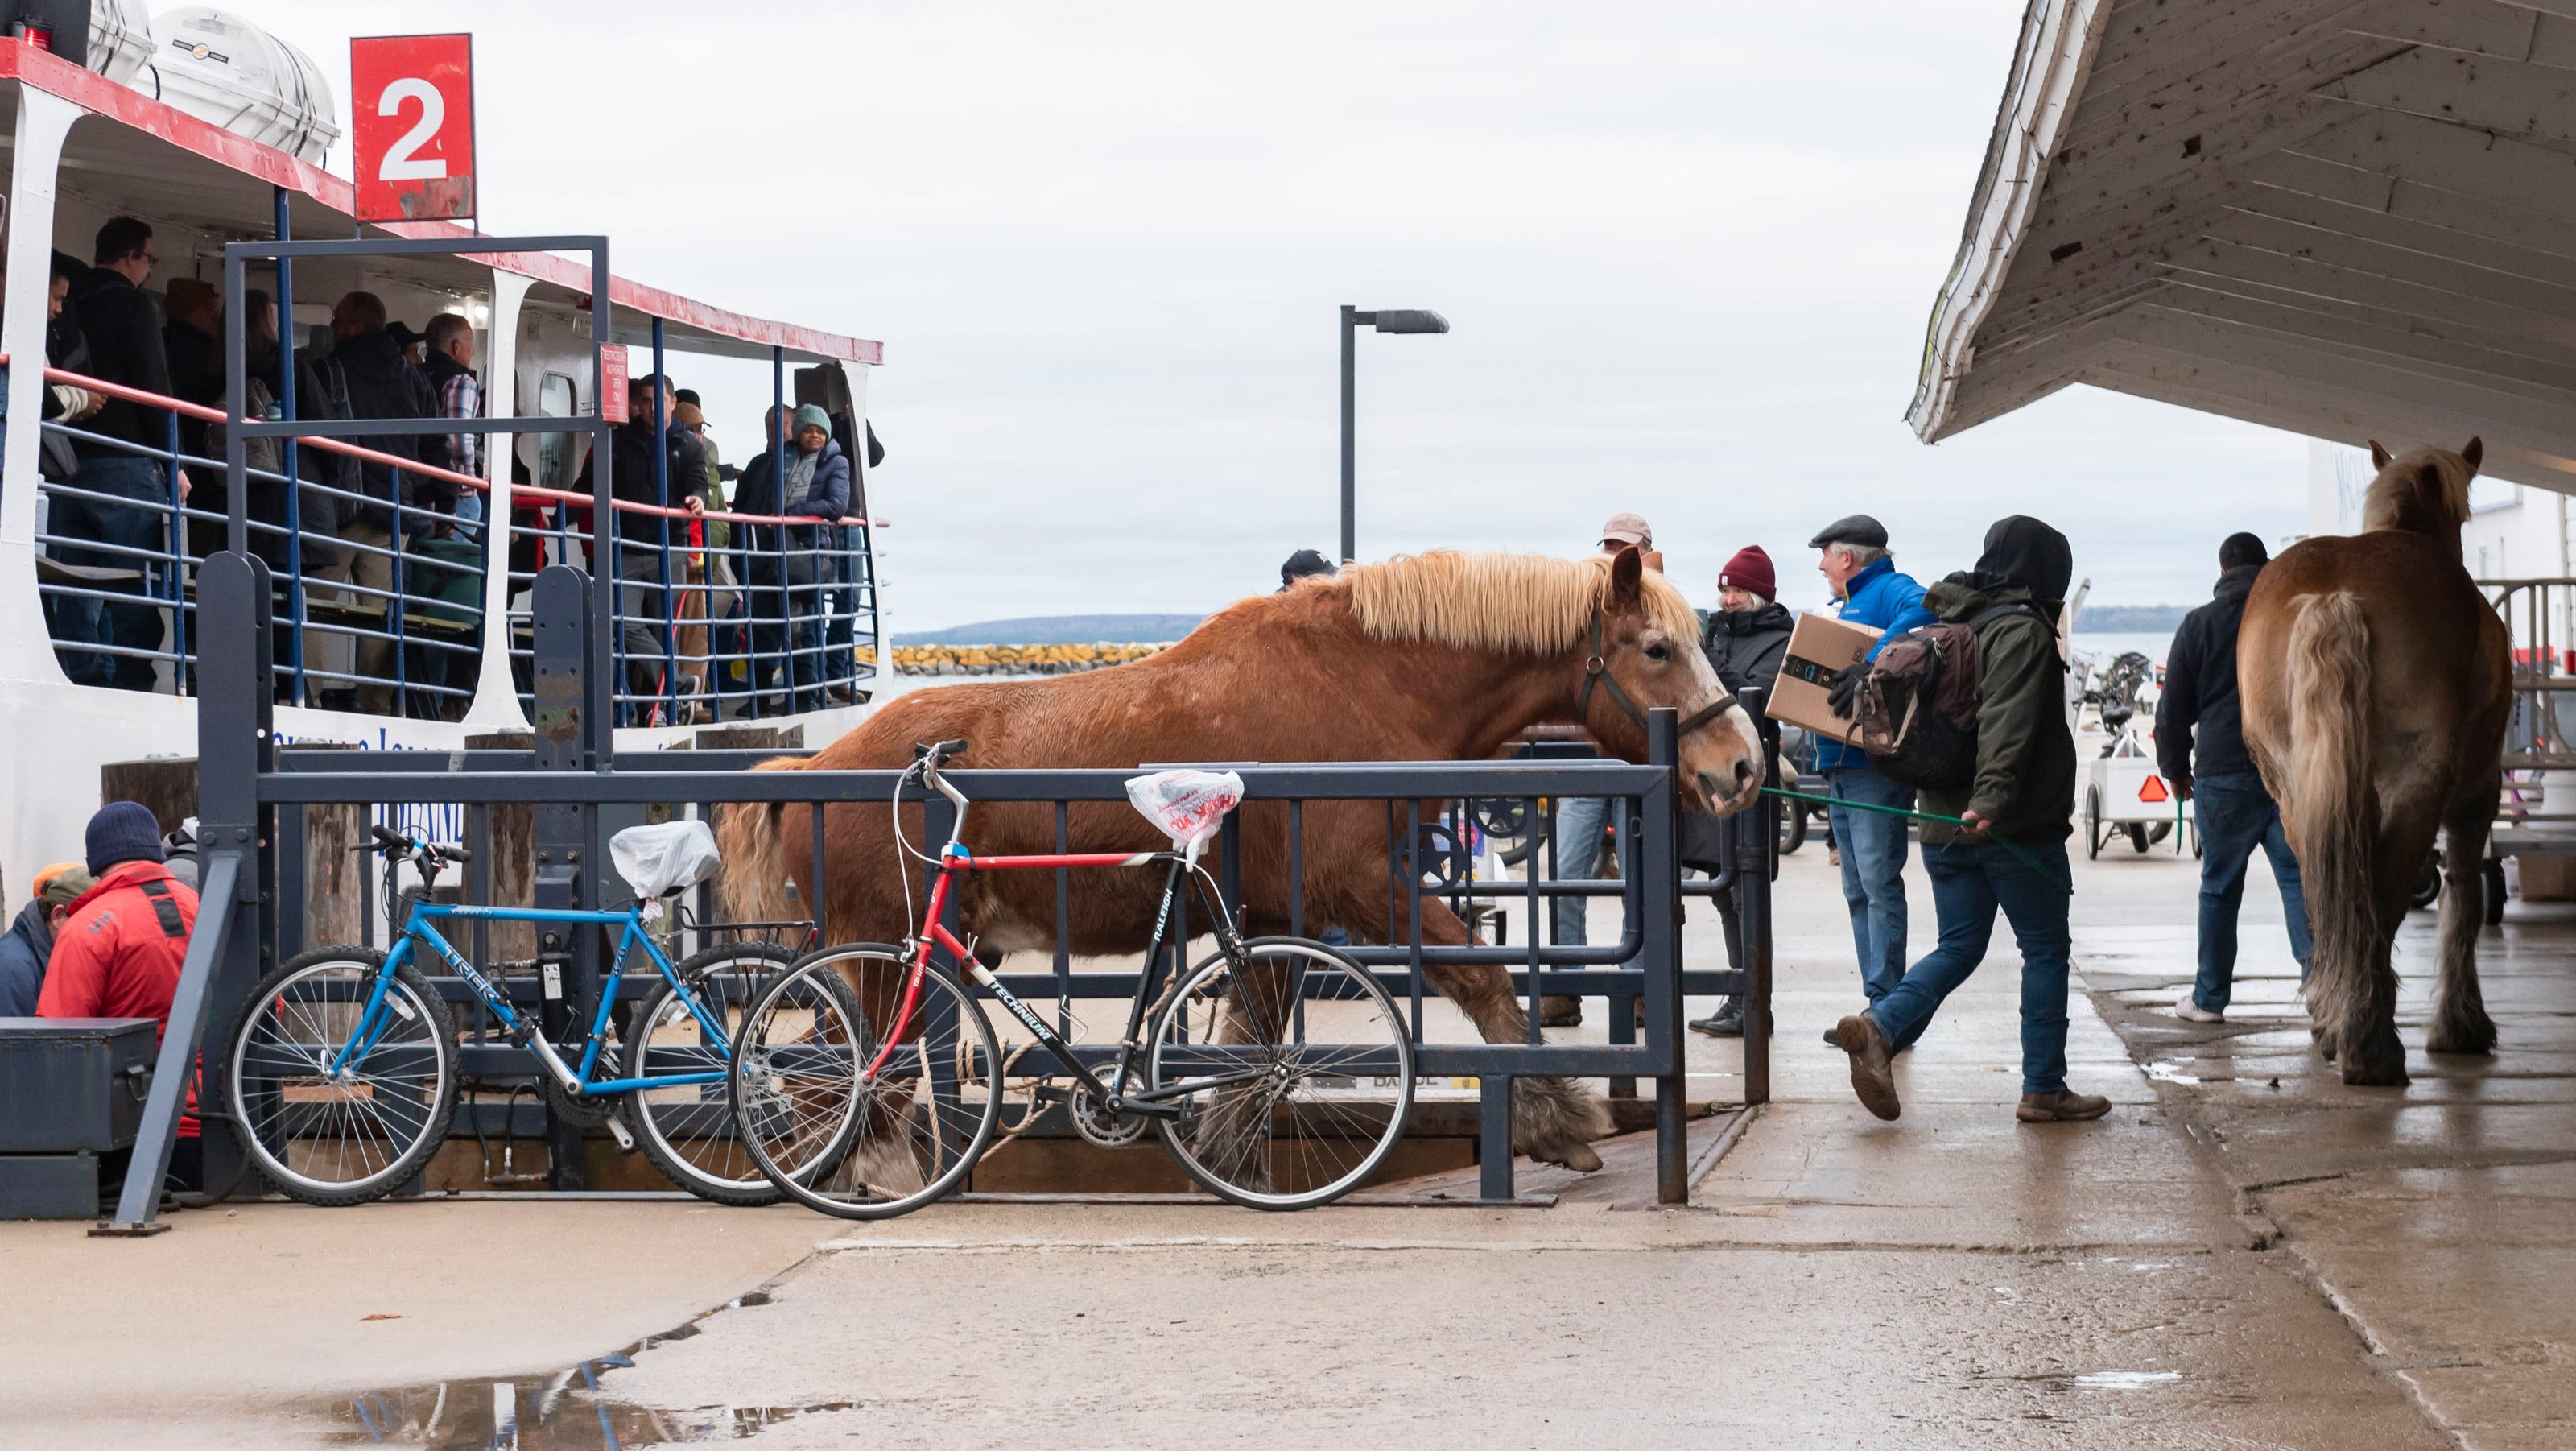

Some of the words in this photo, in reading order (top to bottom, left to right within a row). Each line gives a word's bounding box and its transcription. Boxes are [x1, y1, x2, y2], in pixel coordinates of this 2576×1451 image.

[378, 77, 448, 180] 2
[1153, 888, 1173, 942] RALEIGH
[445, 945, 502, 1001] TREK
[990, 982, 1052, 1040] TECHNIUM
